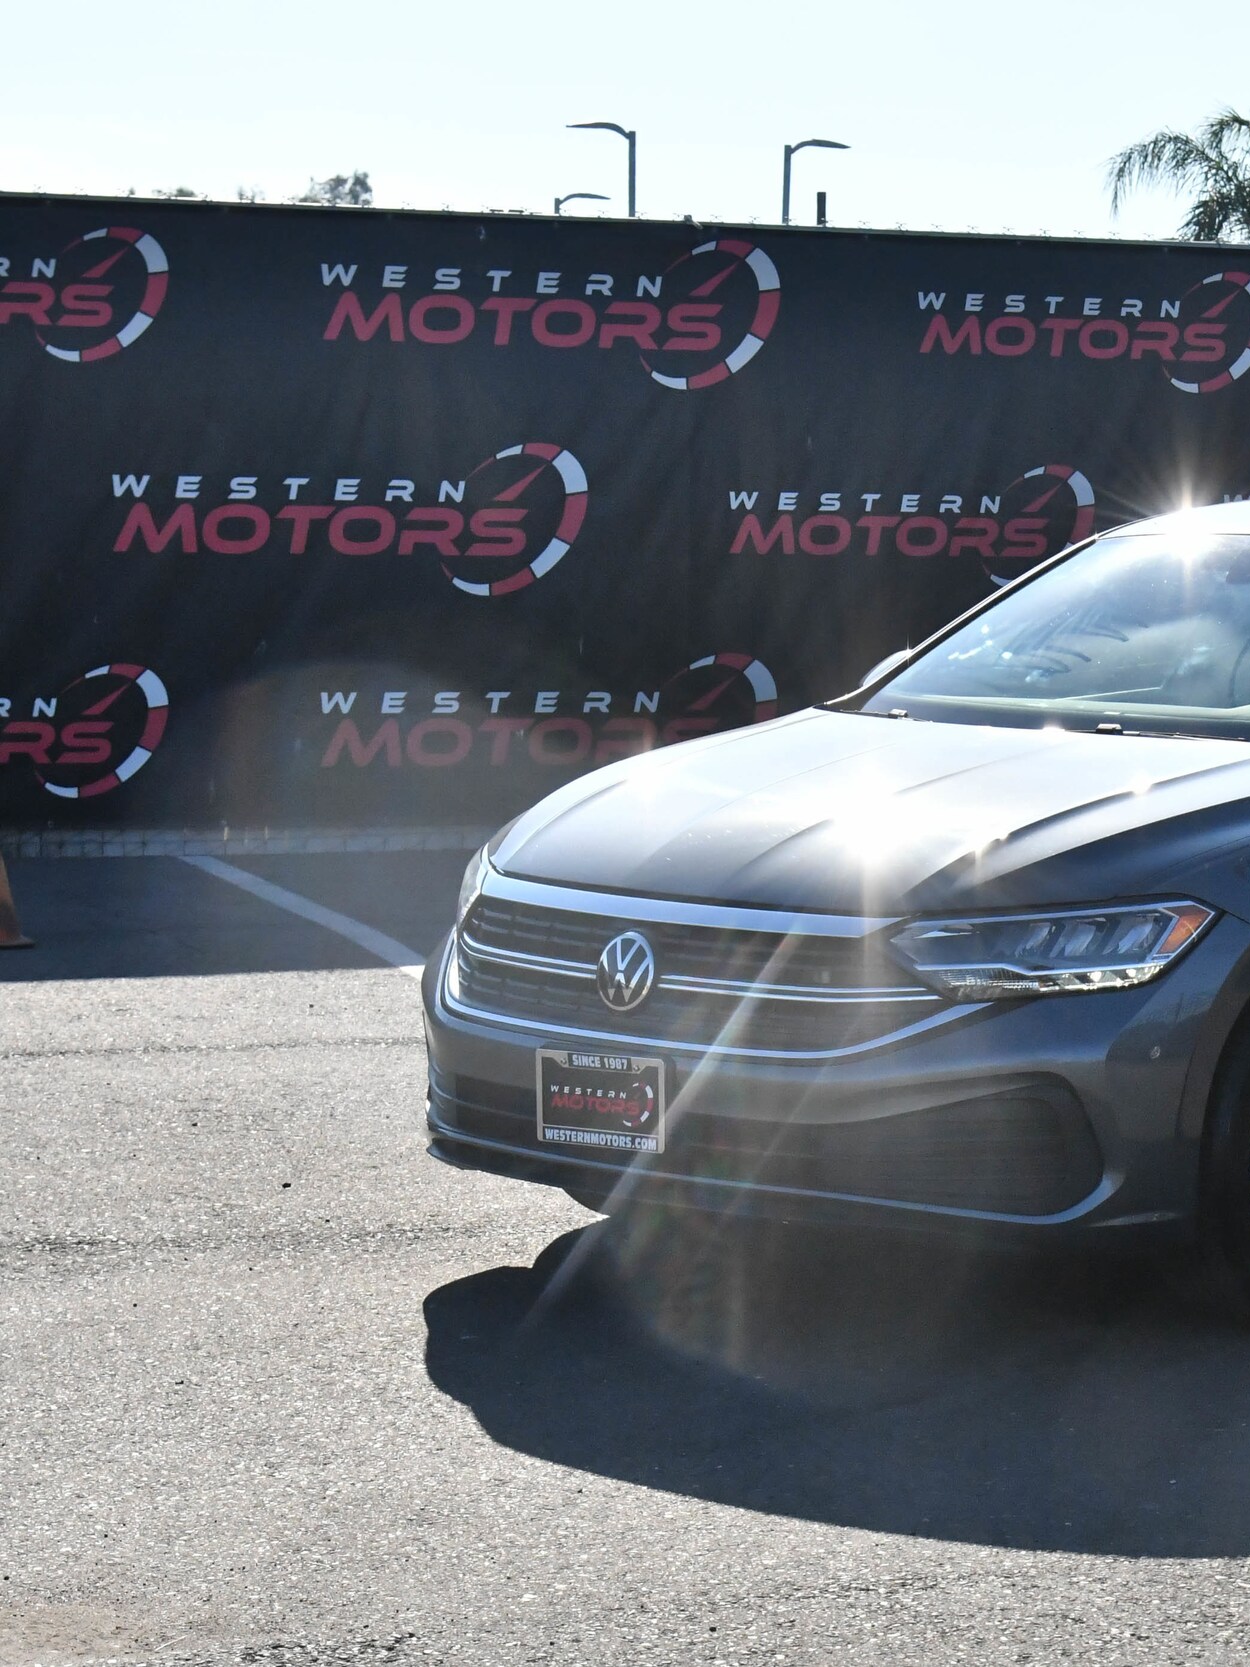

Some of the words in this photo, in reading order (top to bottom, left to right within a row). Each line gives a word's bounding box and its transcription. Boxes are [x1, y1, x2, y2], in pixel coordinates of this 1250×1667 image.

[320, 262, 662, 297] WESTERN
[917, 291, 1181, 319] WESTERN
[322, 291, 723, 351] MOTORS
[919, 313, 1227, 362] MOTORS
[111, 473, 466, 503] WESTERN
[729, 490, 1001, 514] WESTERN
[112, 502, 529, 557] MOTORS
[730, 513, 1049, 557] MOTORS
[320, 691, 660, 714] WESTERN
[572, 1054, 601, 1068] SINCE
[604, 1057, 628, 1070] 1987
[550, 1085, 627, 1099] WESTERN
[551, 1094, 641, 1116] MOTORS
[544, 1128, 657, 1150] WESTERNMOTORS.COM
